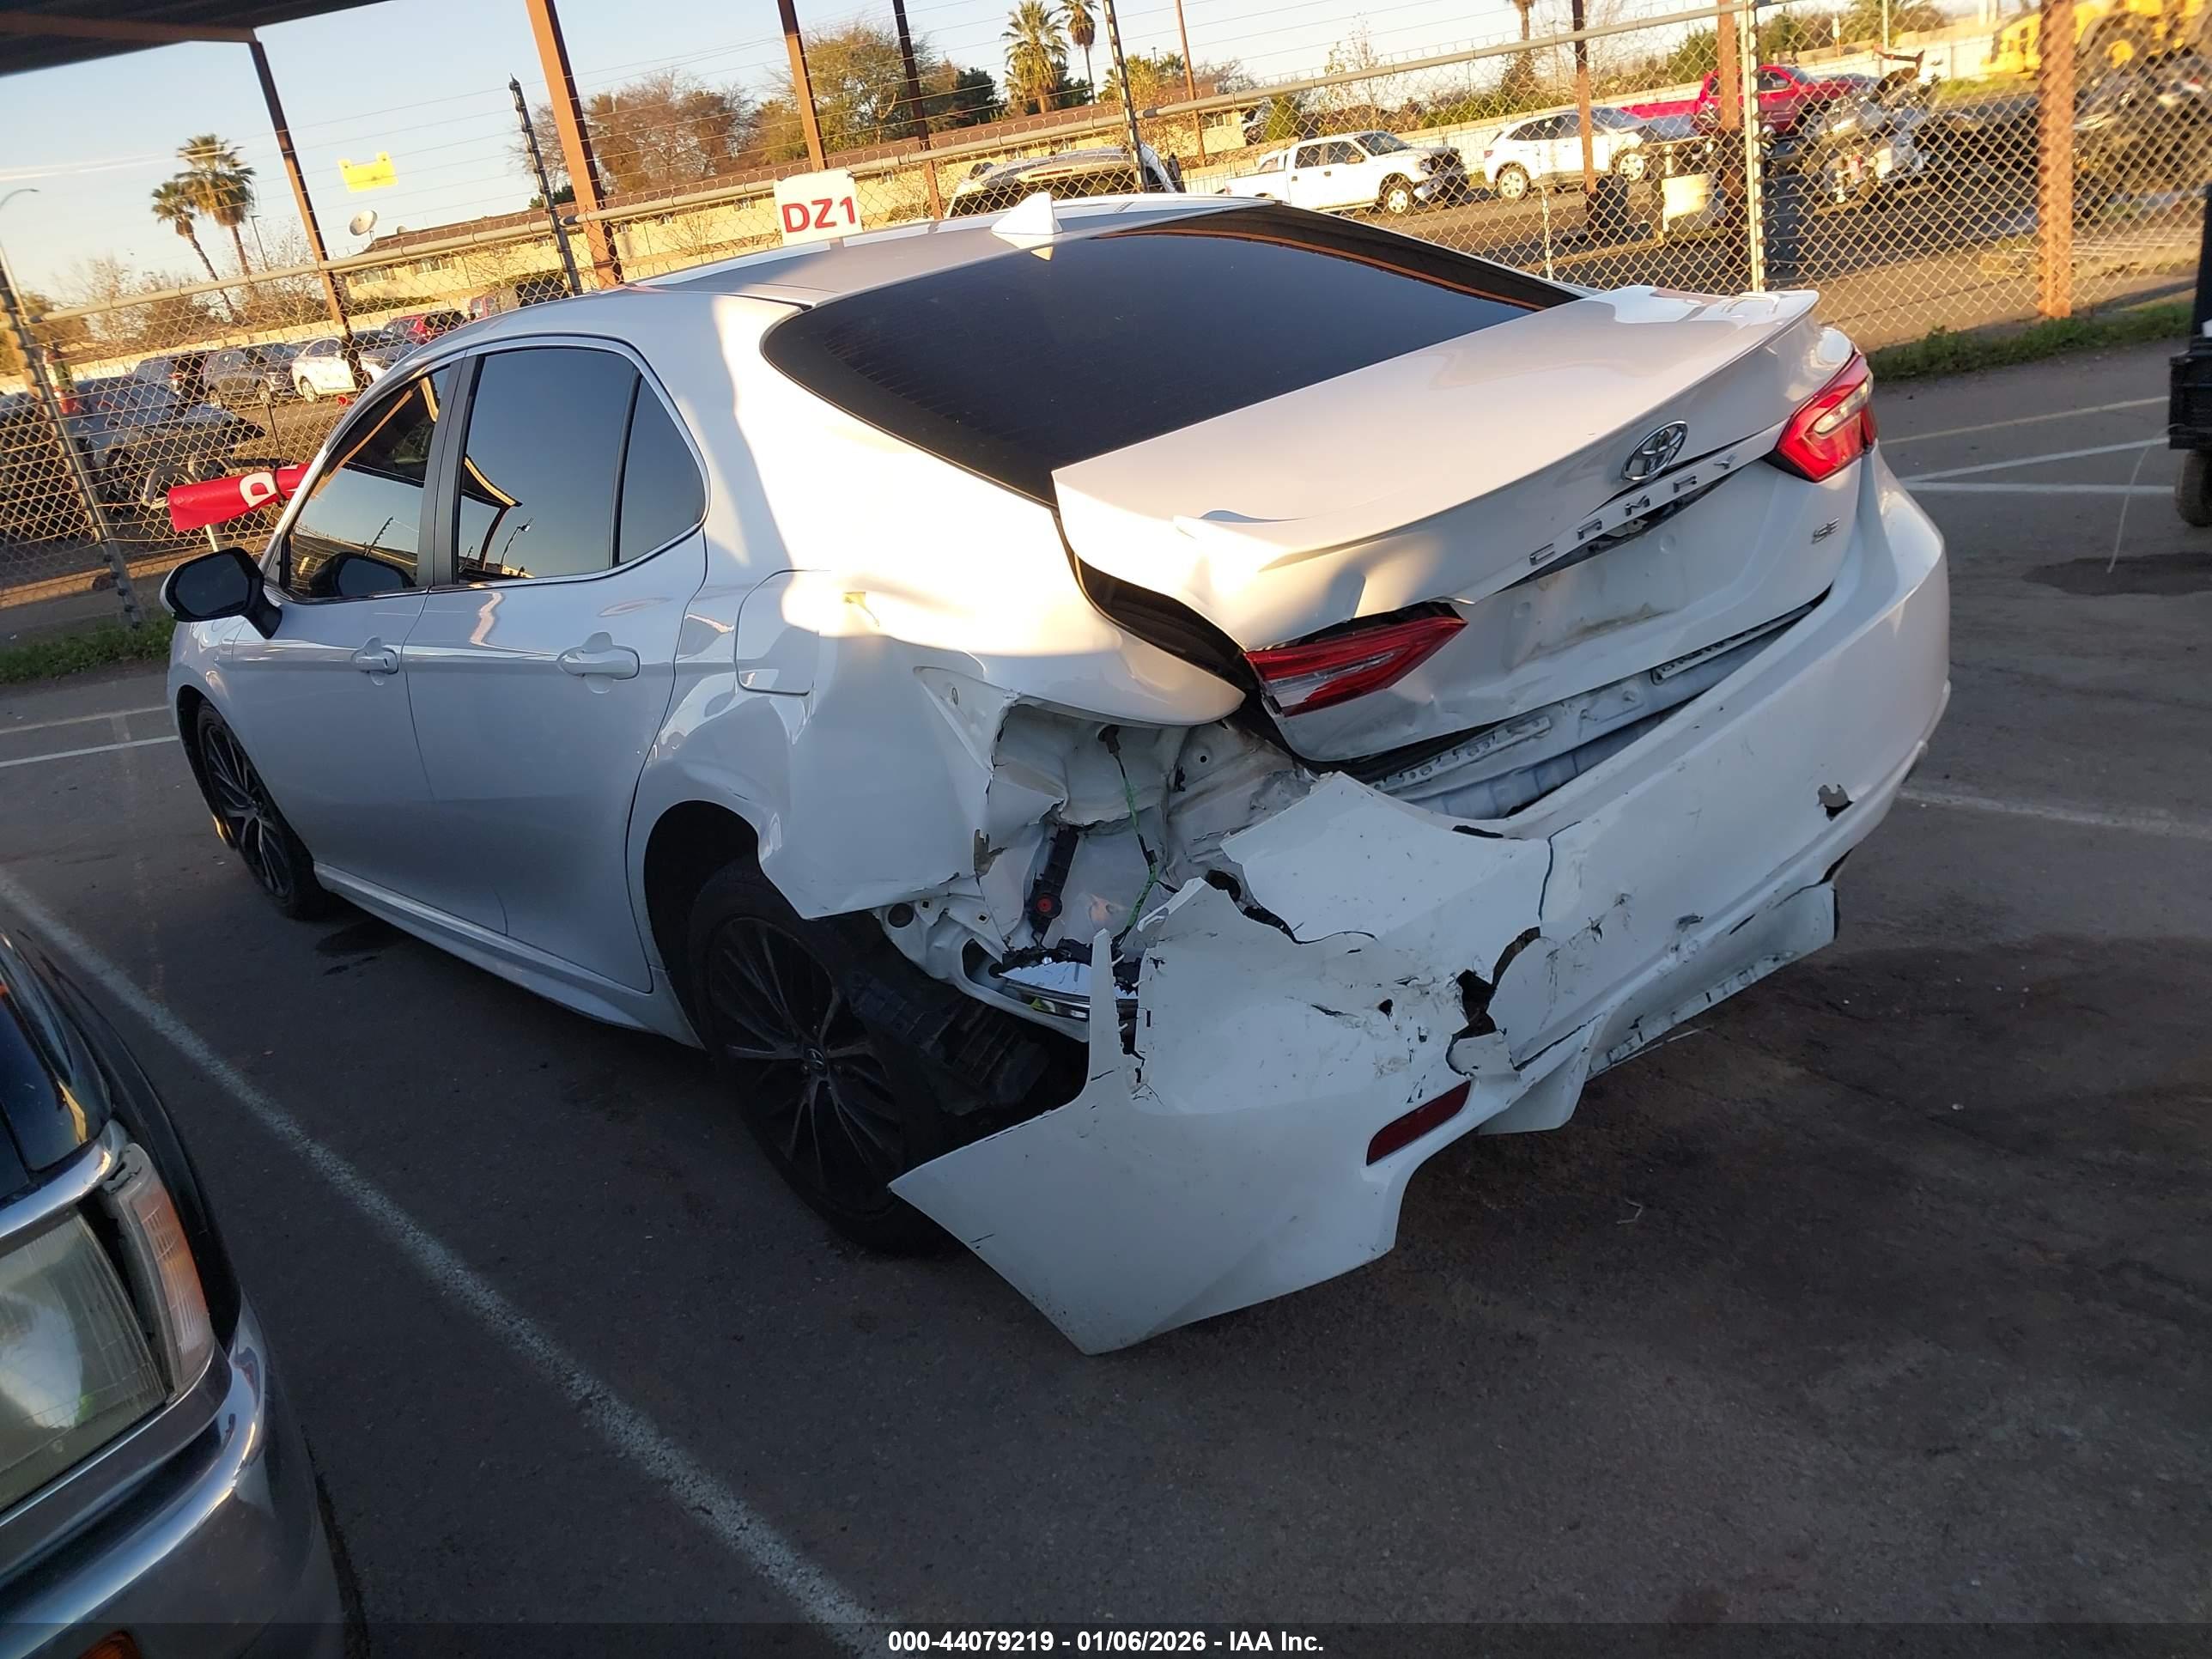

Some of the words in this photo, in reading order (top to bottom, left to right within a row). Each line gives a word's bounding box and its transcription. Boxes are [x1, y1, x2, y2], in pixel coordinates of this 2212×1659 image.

[781, 196, 856, 234] DZ1
[1529, 453, 1736, 566] CAMRY
[1811, 518, 1839, 544] SE
